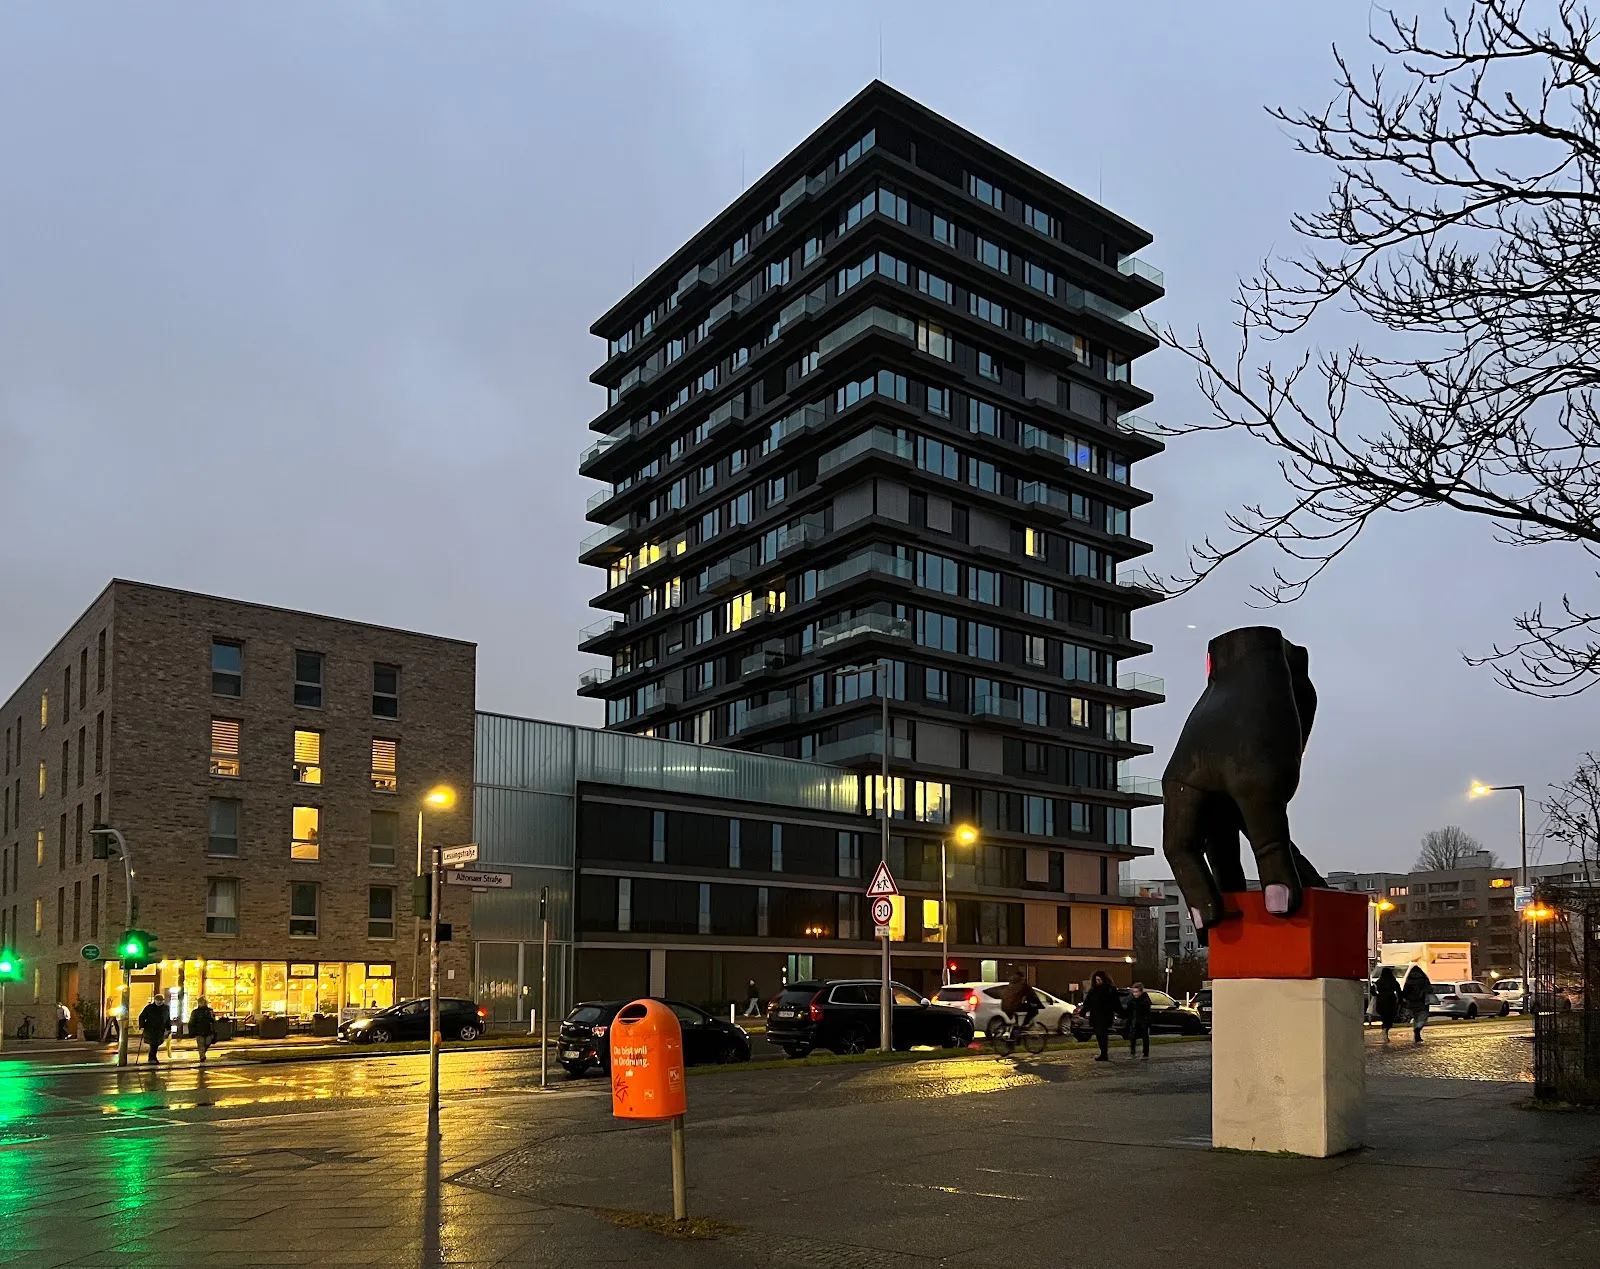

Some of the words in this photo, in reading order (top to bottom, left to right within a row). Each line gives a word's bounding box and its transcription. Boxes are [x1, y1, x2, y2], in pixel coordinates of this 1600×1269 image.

[443, 848, 475, 860] Lessingstraße
[455, 872, 482, 882] Altonaer
[483, 874, 503, 885] Straße
[876, 905, 888, 917] 30
[613, 1046, 621, 1055] Du
[621, 1046, 633, 1055] bist
[634, 1045, 647, 1055] voll
